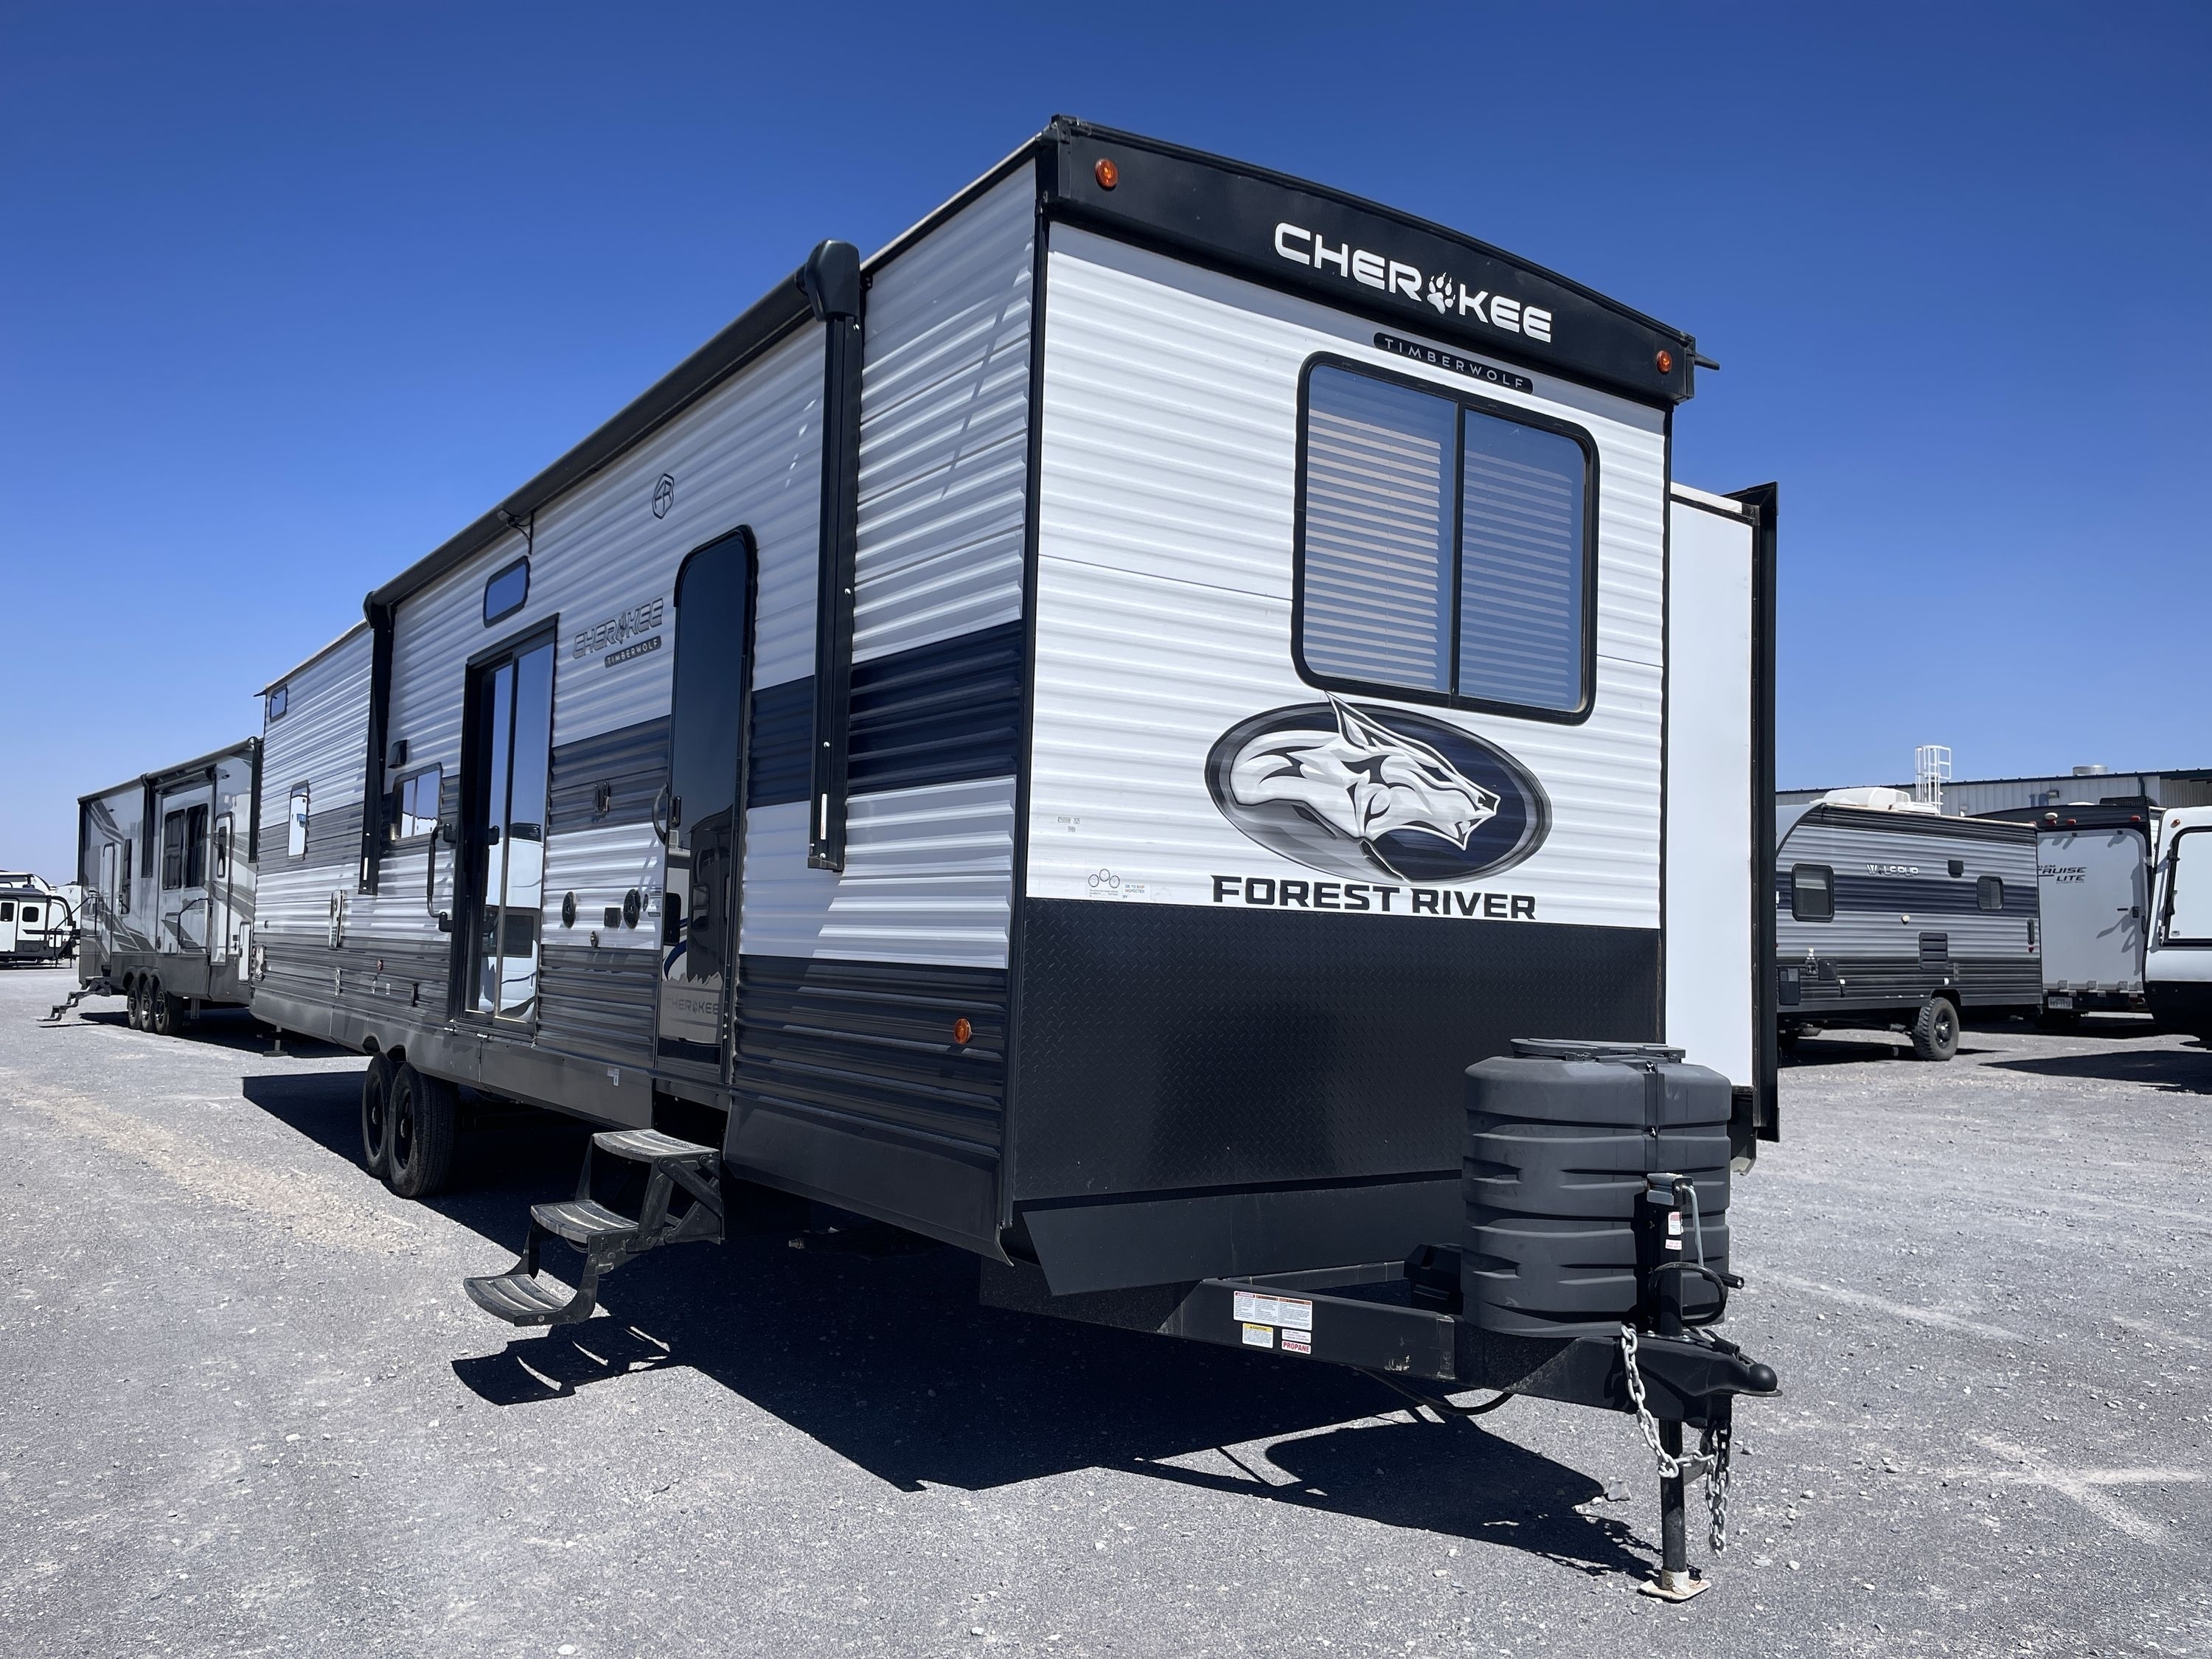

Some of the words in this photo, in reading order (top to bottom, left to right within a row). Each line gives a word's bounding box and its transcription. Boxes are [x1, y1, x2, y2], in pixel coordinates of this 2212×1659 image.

[1384, 337, 1524, 389] TIMBERWOLF
[607, 639, 658, 666] TIMBERWOLF
[1210, 874, 1400, 913] FOREST
[1410, 888, 1537, 920] RIVER
[1283, 1341, 1310, 1353] PROPANE
